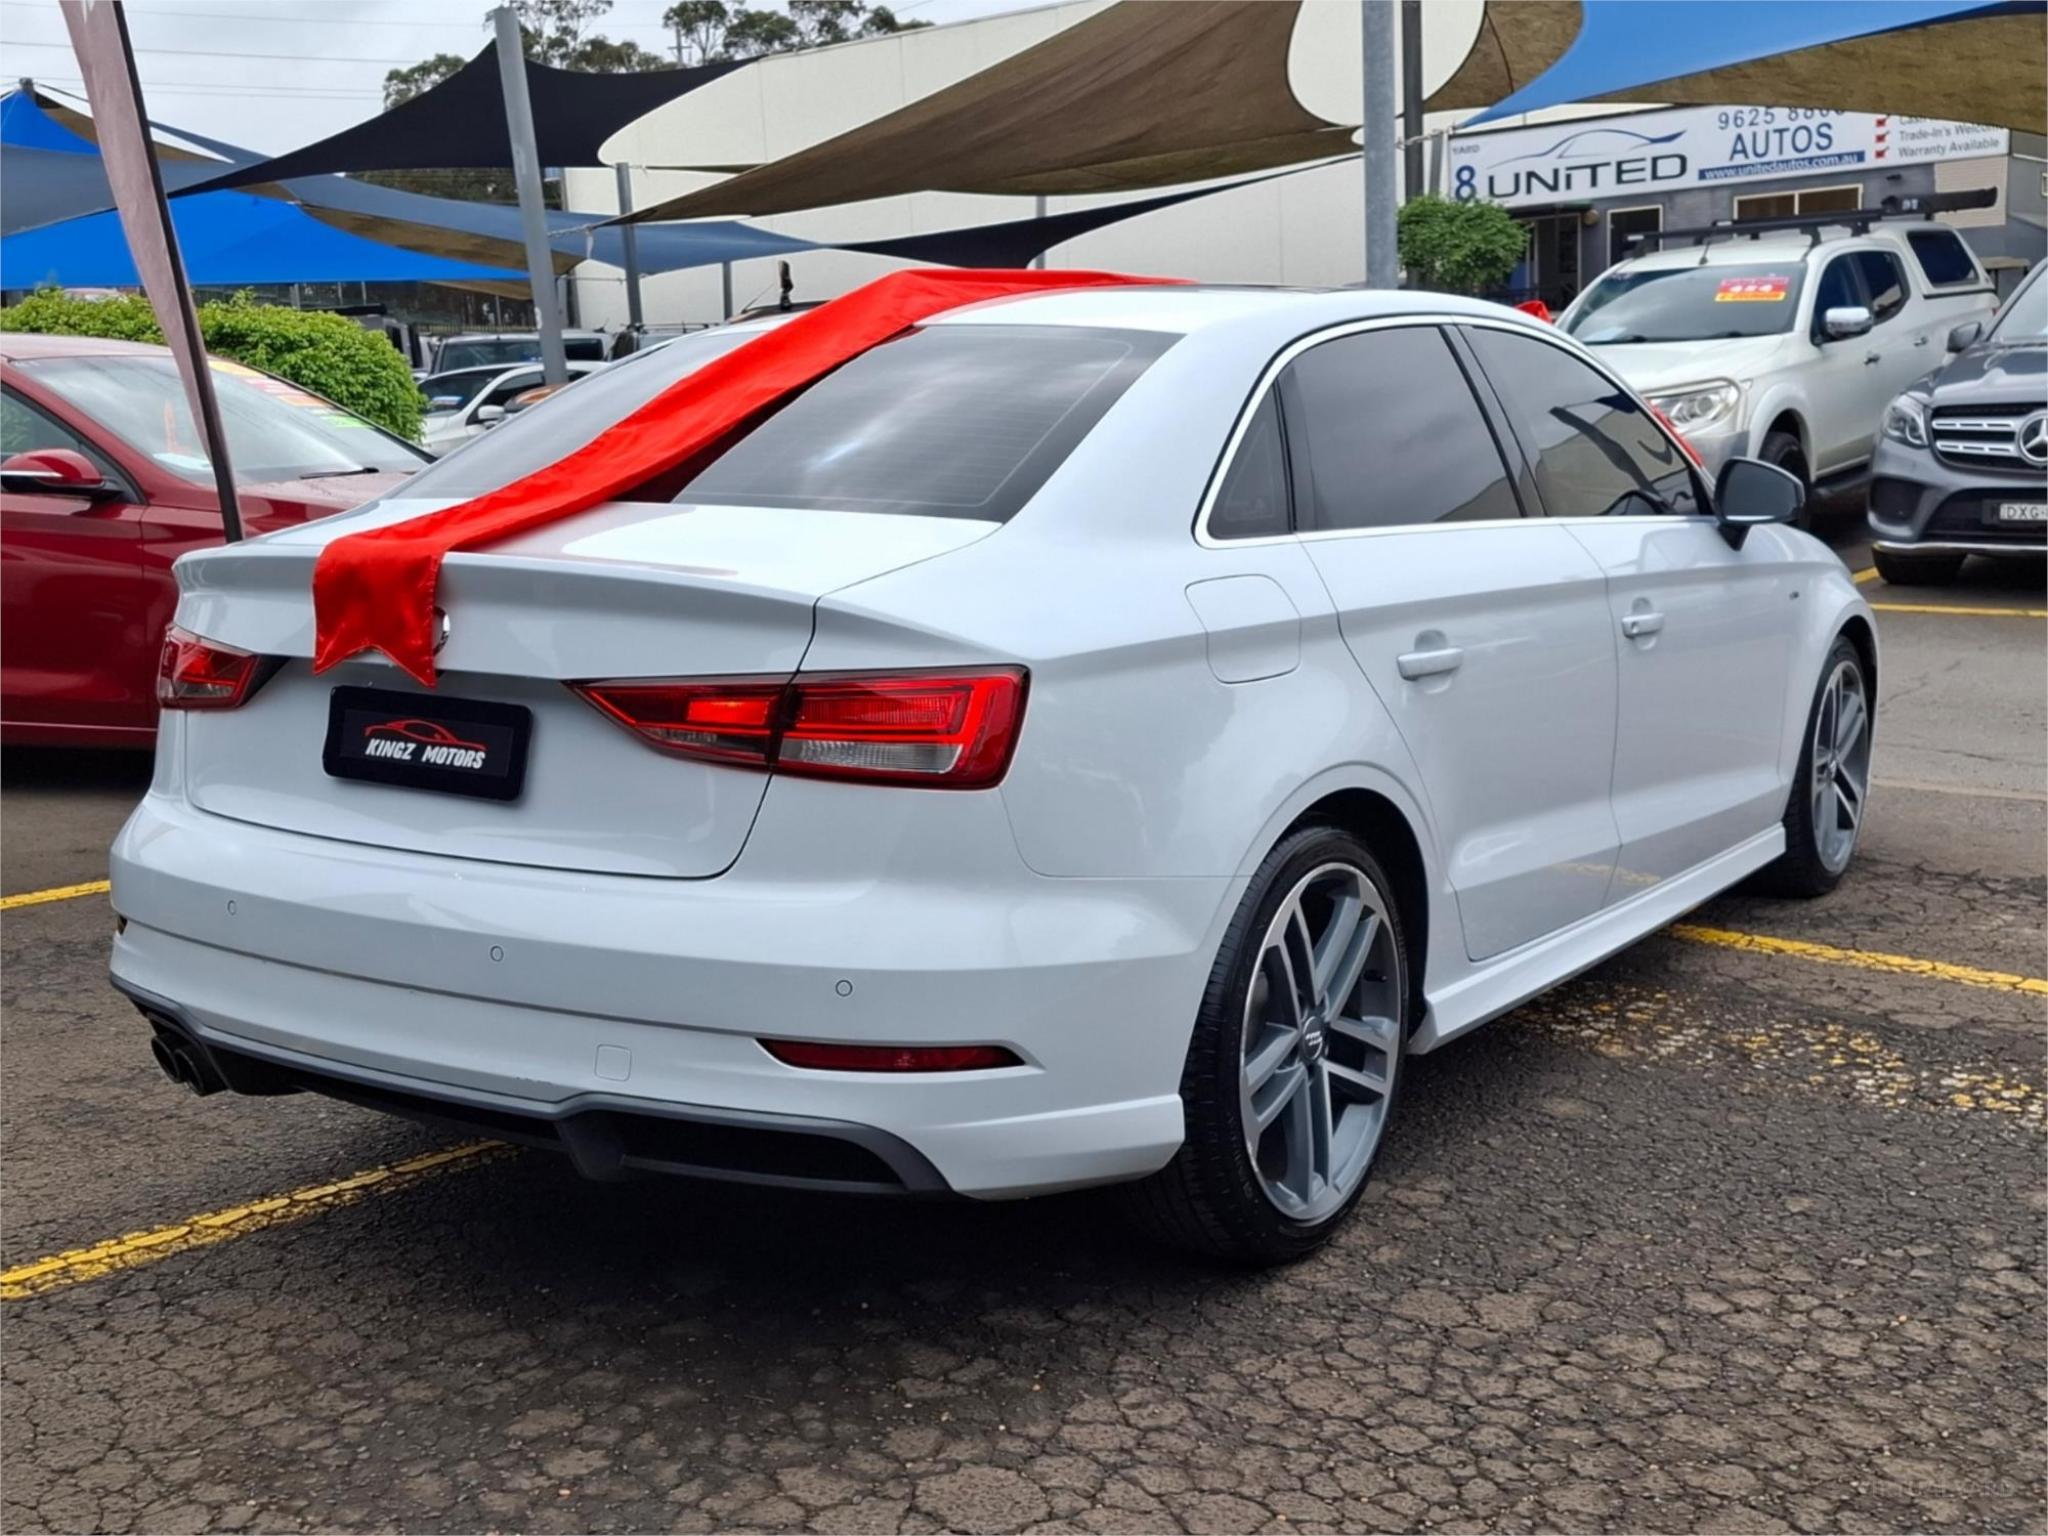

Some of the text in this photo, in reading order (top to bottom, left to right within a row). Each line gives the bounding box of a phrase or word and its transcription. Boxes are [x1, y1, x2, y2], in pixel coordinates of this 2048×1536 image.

[1718, 108, 1775, 130] 9625
[1729, 122, 1833, 161] AUTOS
[1899, 138, 2000, 158] Warranty Available
[1704, 153, 1858, 180] www.unitedautos.com.au
[1455, 165, 1476, 201] 8
[365, 738, 486, 769] KINGZ MOTORS
